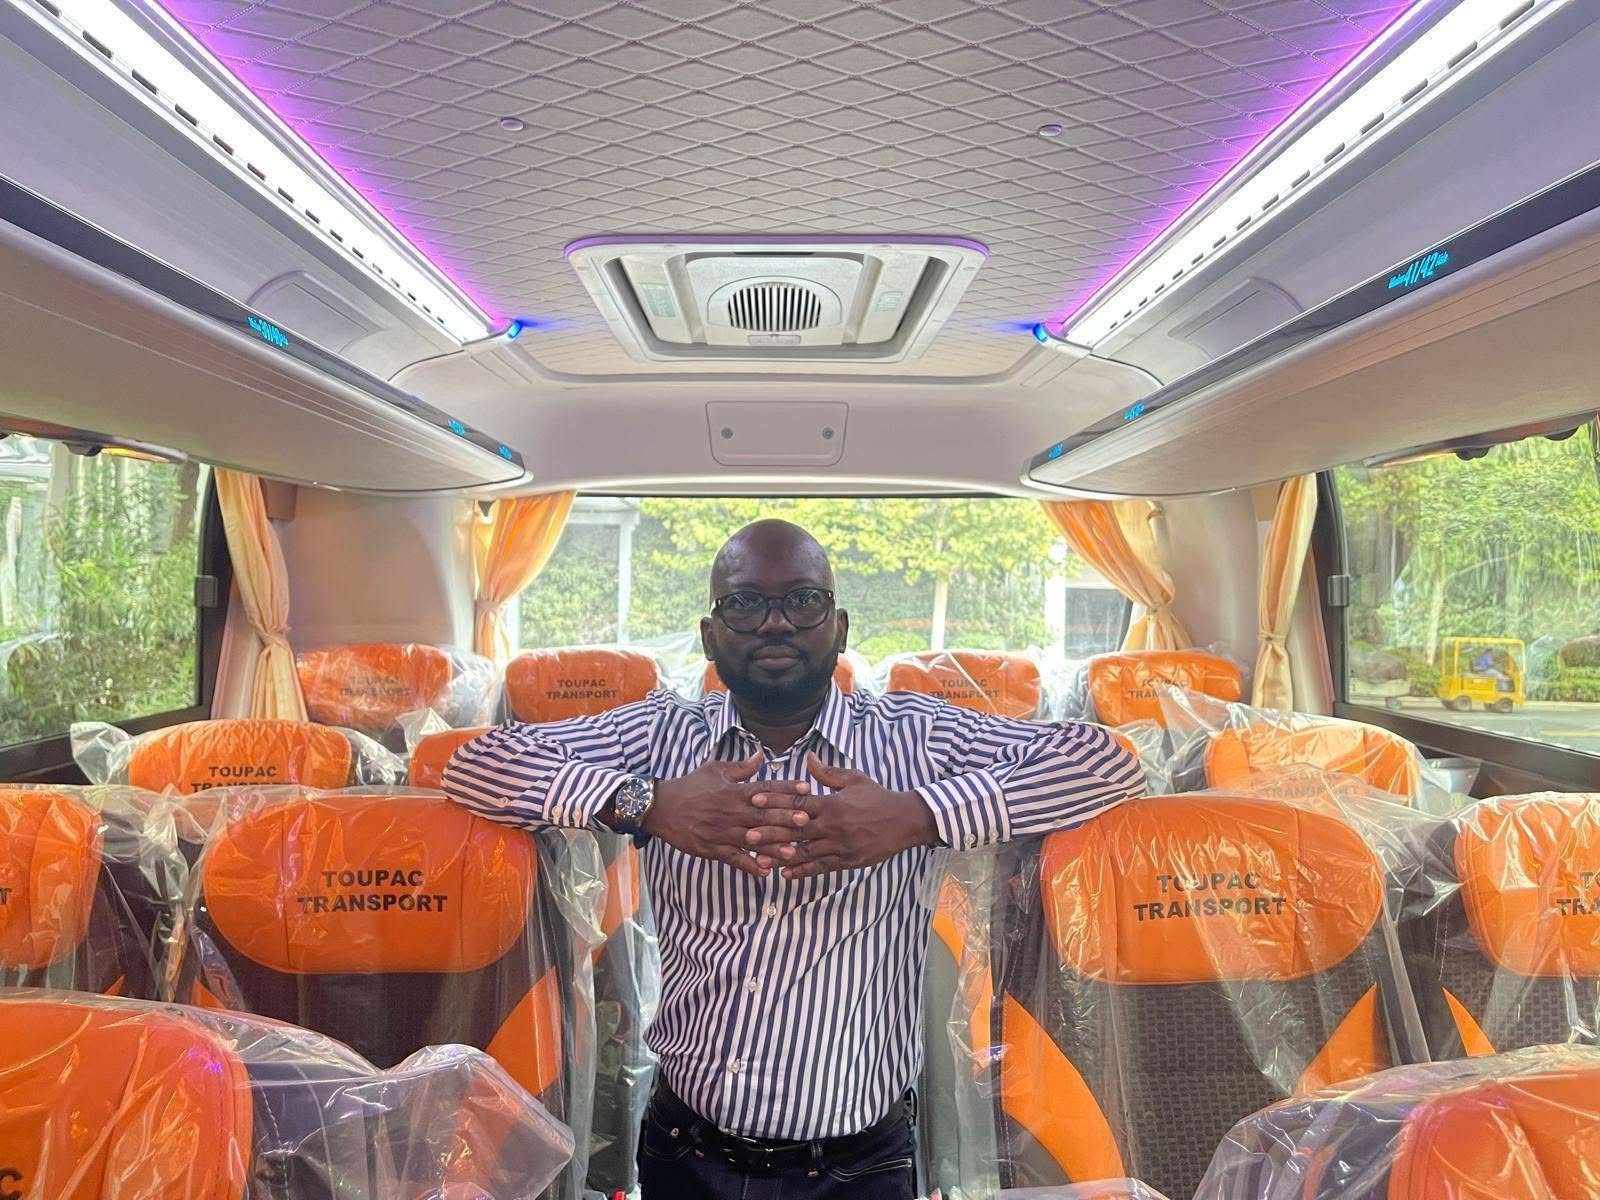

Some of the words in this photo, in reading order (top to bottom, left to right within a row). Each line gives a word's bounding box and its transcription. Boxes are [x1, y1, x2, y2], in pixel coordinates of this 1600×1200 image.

[557, 679, 606, 688] TOUPAC
[545, 689, 618, 699] TRANSPORT
[208, 766, 277, 777] TOUPAC
[321, 869, 424, 887] TOUPAC
[1157, 871, 1261, 893] TOUPAC
[297, 893, 448, 913] TRANSPORT
[1133, 896, 1287, 921] TRANSPORT
